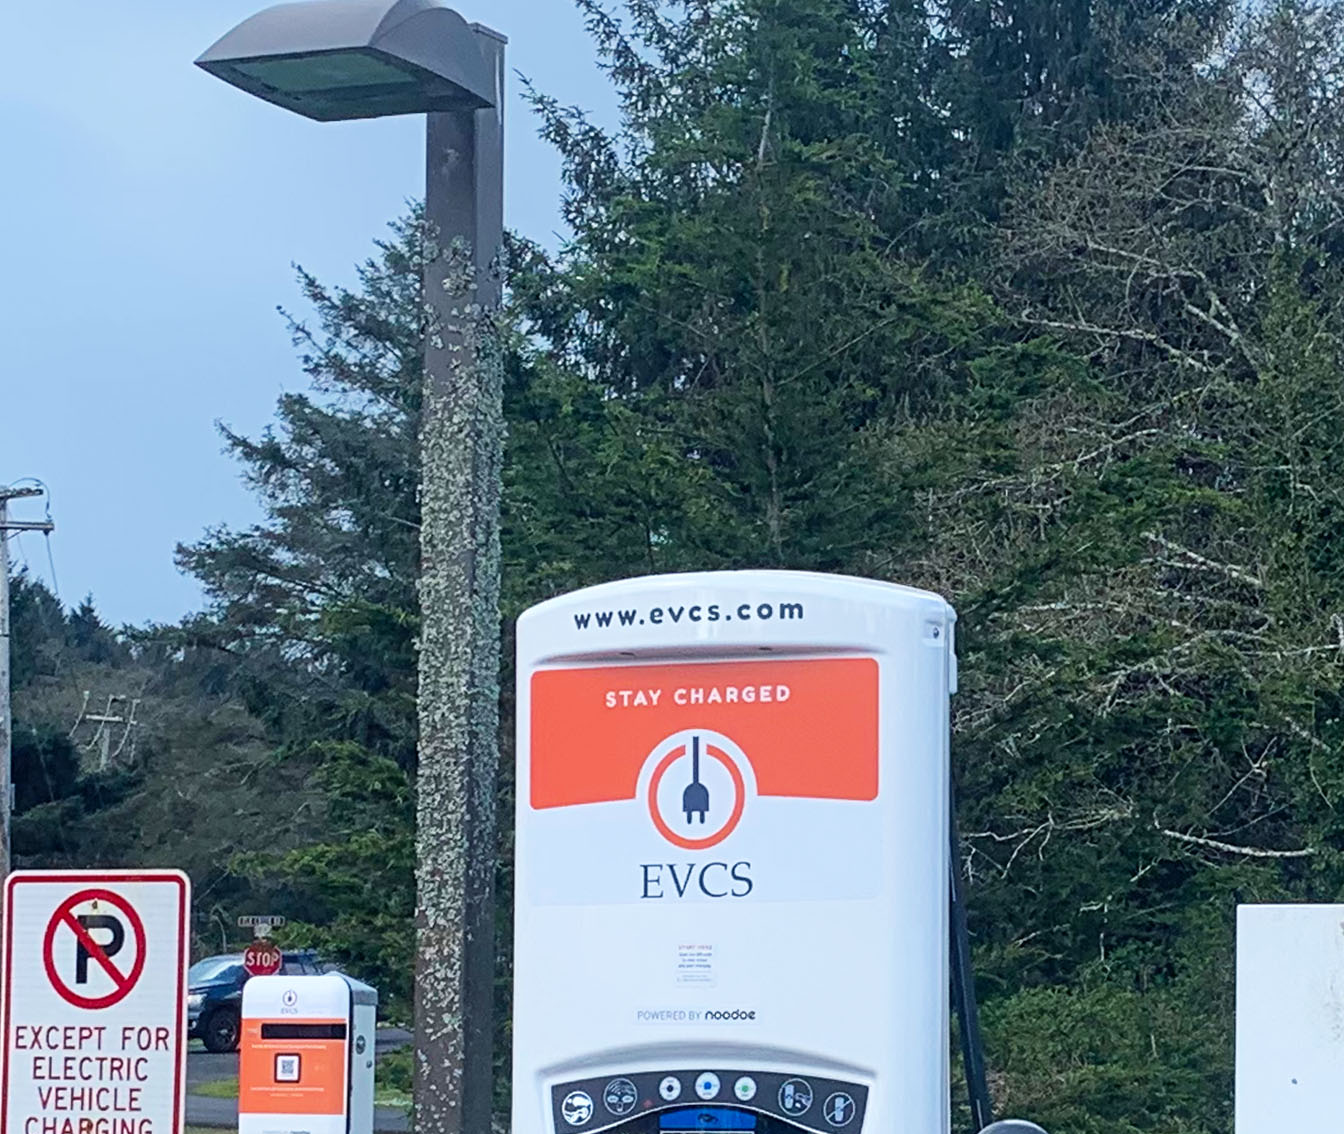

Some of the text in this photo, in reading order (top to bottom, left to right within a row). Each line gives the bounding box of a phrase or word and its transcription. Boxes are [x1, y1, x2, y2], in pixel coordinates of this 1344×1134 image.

[573, 600, 805, 630] www.evcs.com
[605, 684, 791, 708] STAY CHARGED
[639, 862, 754, 899] EVCS
[245, 953, 280, 968] STOP
[637, 1008, 756, 1021] POWERED BY noodoe
[15, 1025, 170, 1051] EXCEPT FOR
[32, 1056, 149, 1081] ELECTRIC
[37, 1086, 142, 1112] VEHICLE
